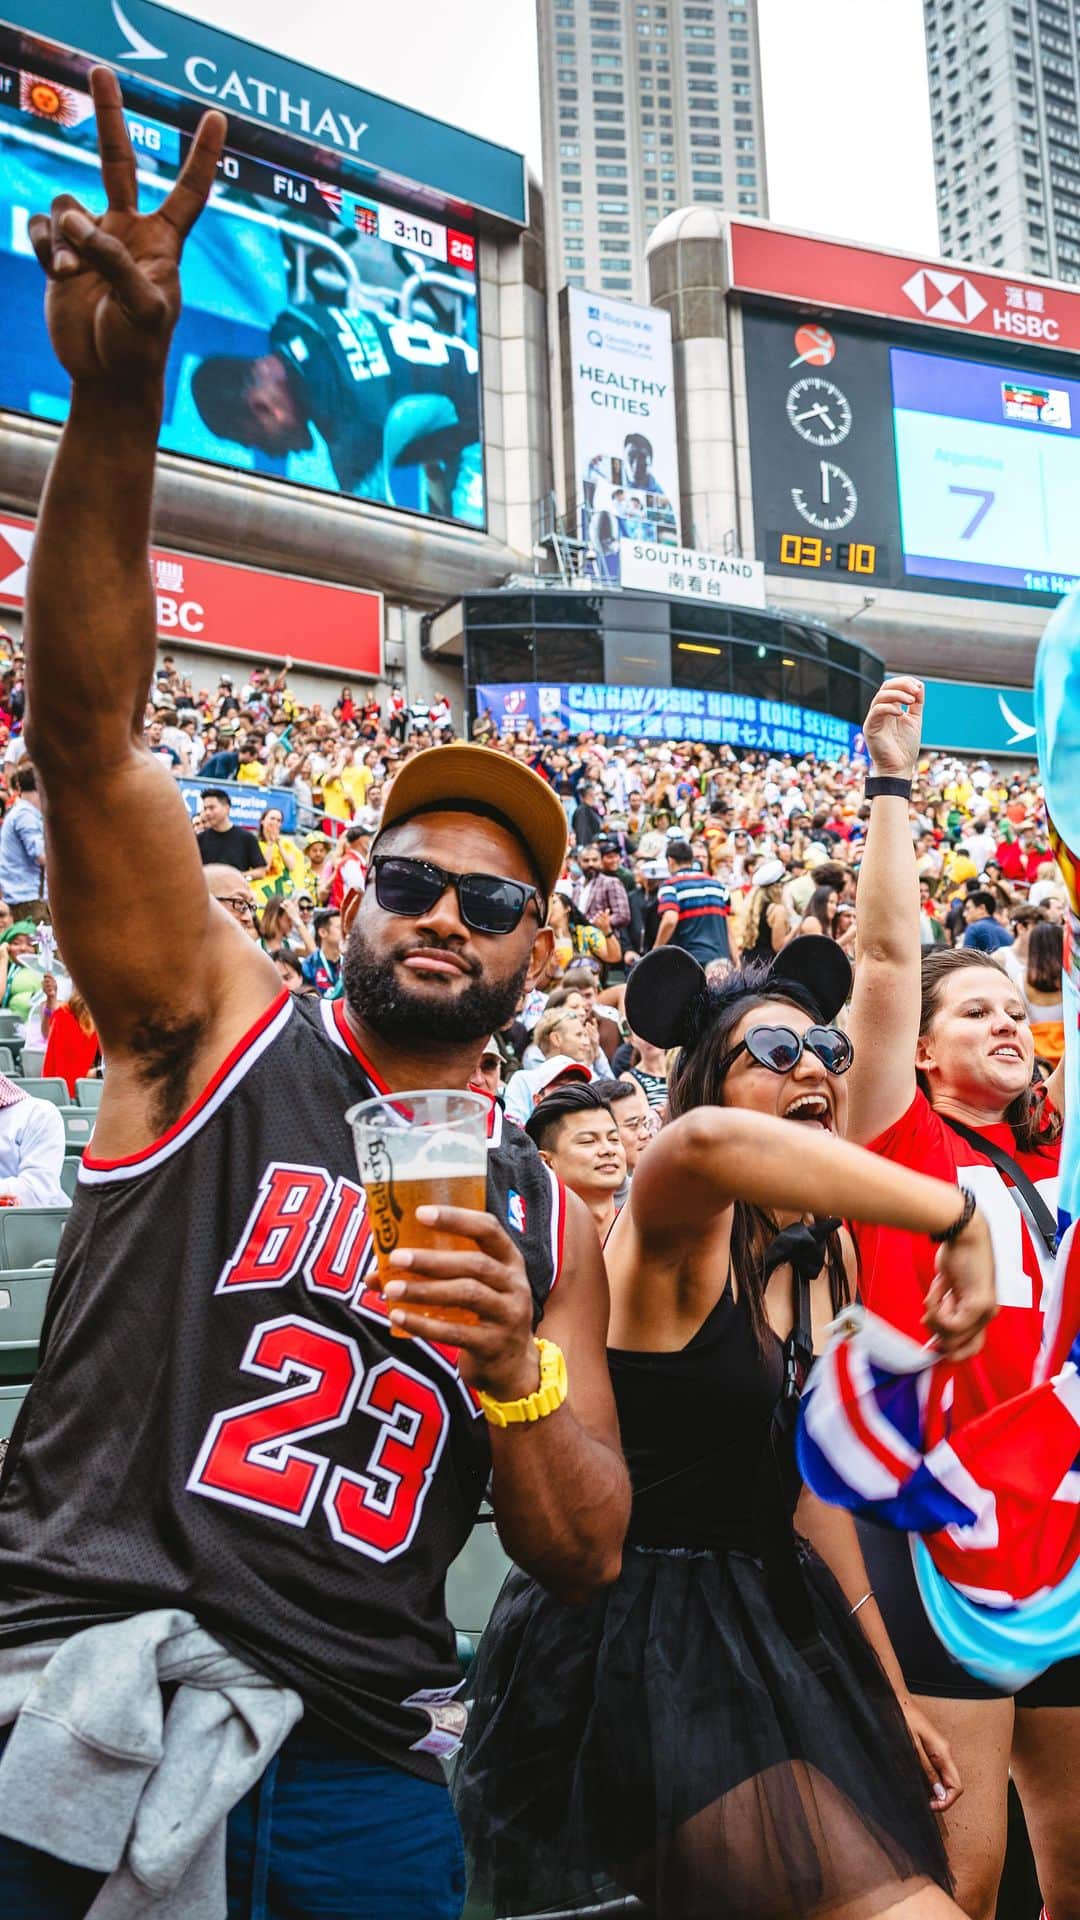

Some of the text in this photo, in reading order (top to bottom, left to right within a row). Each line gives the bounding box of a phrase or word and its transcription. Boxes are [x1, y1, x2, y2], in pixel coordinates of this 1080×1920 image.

[0, 73, 13, 93] lf
[184, 57, 370, 153] CATHAY
[128, 121, 162, 151] RG
[273, 173, 307, 204] FIJ
[394, 219, 433, 248] 3:10
[992, 308, 1060, 341] HSBC
[579, 364, 667, 398] HEALTHY
[591, 390, 650, 417] CITIES
[948, 485, 995, 540] 7
[633, 545, 753, 579] SOUTH STAND
[780, 534, 876, 575] 03:10
[149, 558, 185, 594] 豐
[668, 571, 721, 597] 南看台
[1023, 571, 1079, 596] 1st Ha
[156, 595, 204, 633] BC
[568, 685, 850, 745] CATHAY/HSBC HONG KONG SEVENS
[366, 1138, 402, 1254] Carlsberg
[185, 1313, 451, 1564] 23
